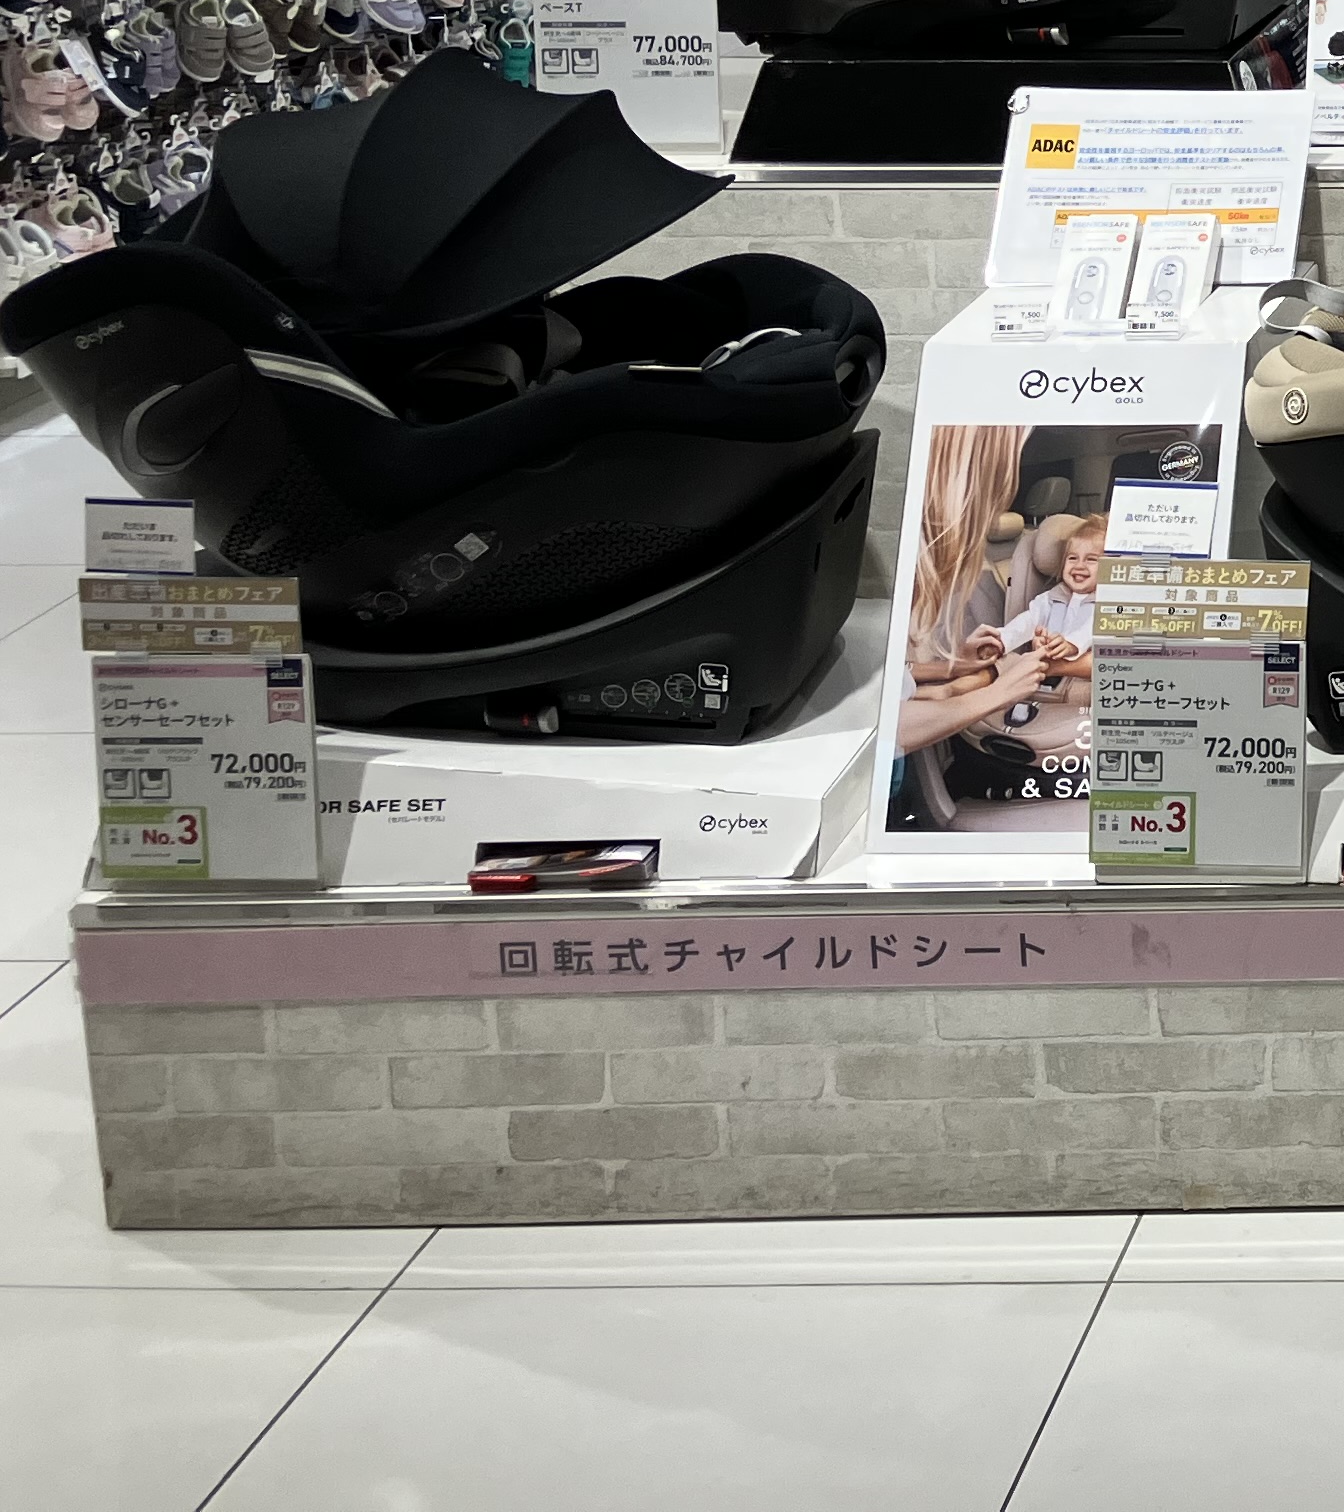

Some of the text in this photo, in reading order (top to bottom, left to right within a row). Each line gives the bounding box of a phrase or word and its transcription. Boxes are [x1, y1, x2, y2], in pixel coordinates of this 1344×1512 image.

[540, 3, 582, 13] ベースT
[633, 35, 712, 53] 77,000円
[1031, 139, 1075, 153] ADAC
[1052, 368, 1145, 406] cybex
[1162, 456, 1199, 471] GERMANY
[1148, 504, 1180, 512] ただいま
[1125, 513, 1198, 524] 品切れしております。
[1110, 565, 1297, 585] 出産準備おまとめフェア
[1165, 589, 1239, 603] 対象商品
[1267, 656, 1296, 664] SELECT
[1099, 679, 1164, 692] シローナG
[1099, 697, 1231, 710] センサーセーフセット
[102, 713, 235, 728] センサーセーフセット
[1203, 737, 1297, 758] 72,000円
[211, 753, 306, 775] 72,000円
[1216, 761, 1296, 775] (税込79,200円)
[348, 799, 402, 813] SAFE
[407, 798, 447, 813] SET
[718, 814, 769, 834] cybex
[1130, 801, 1186, 833] No.3
[499, 932, 1046, 974] 回転式チャイルドシート
